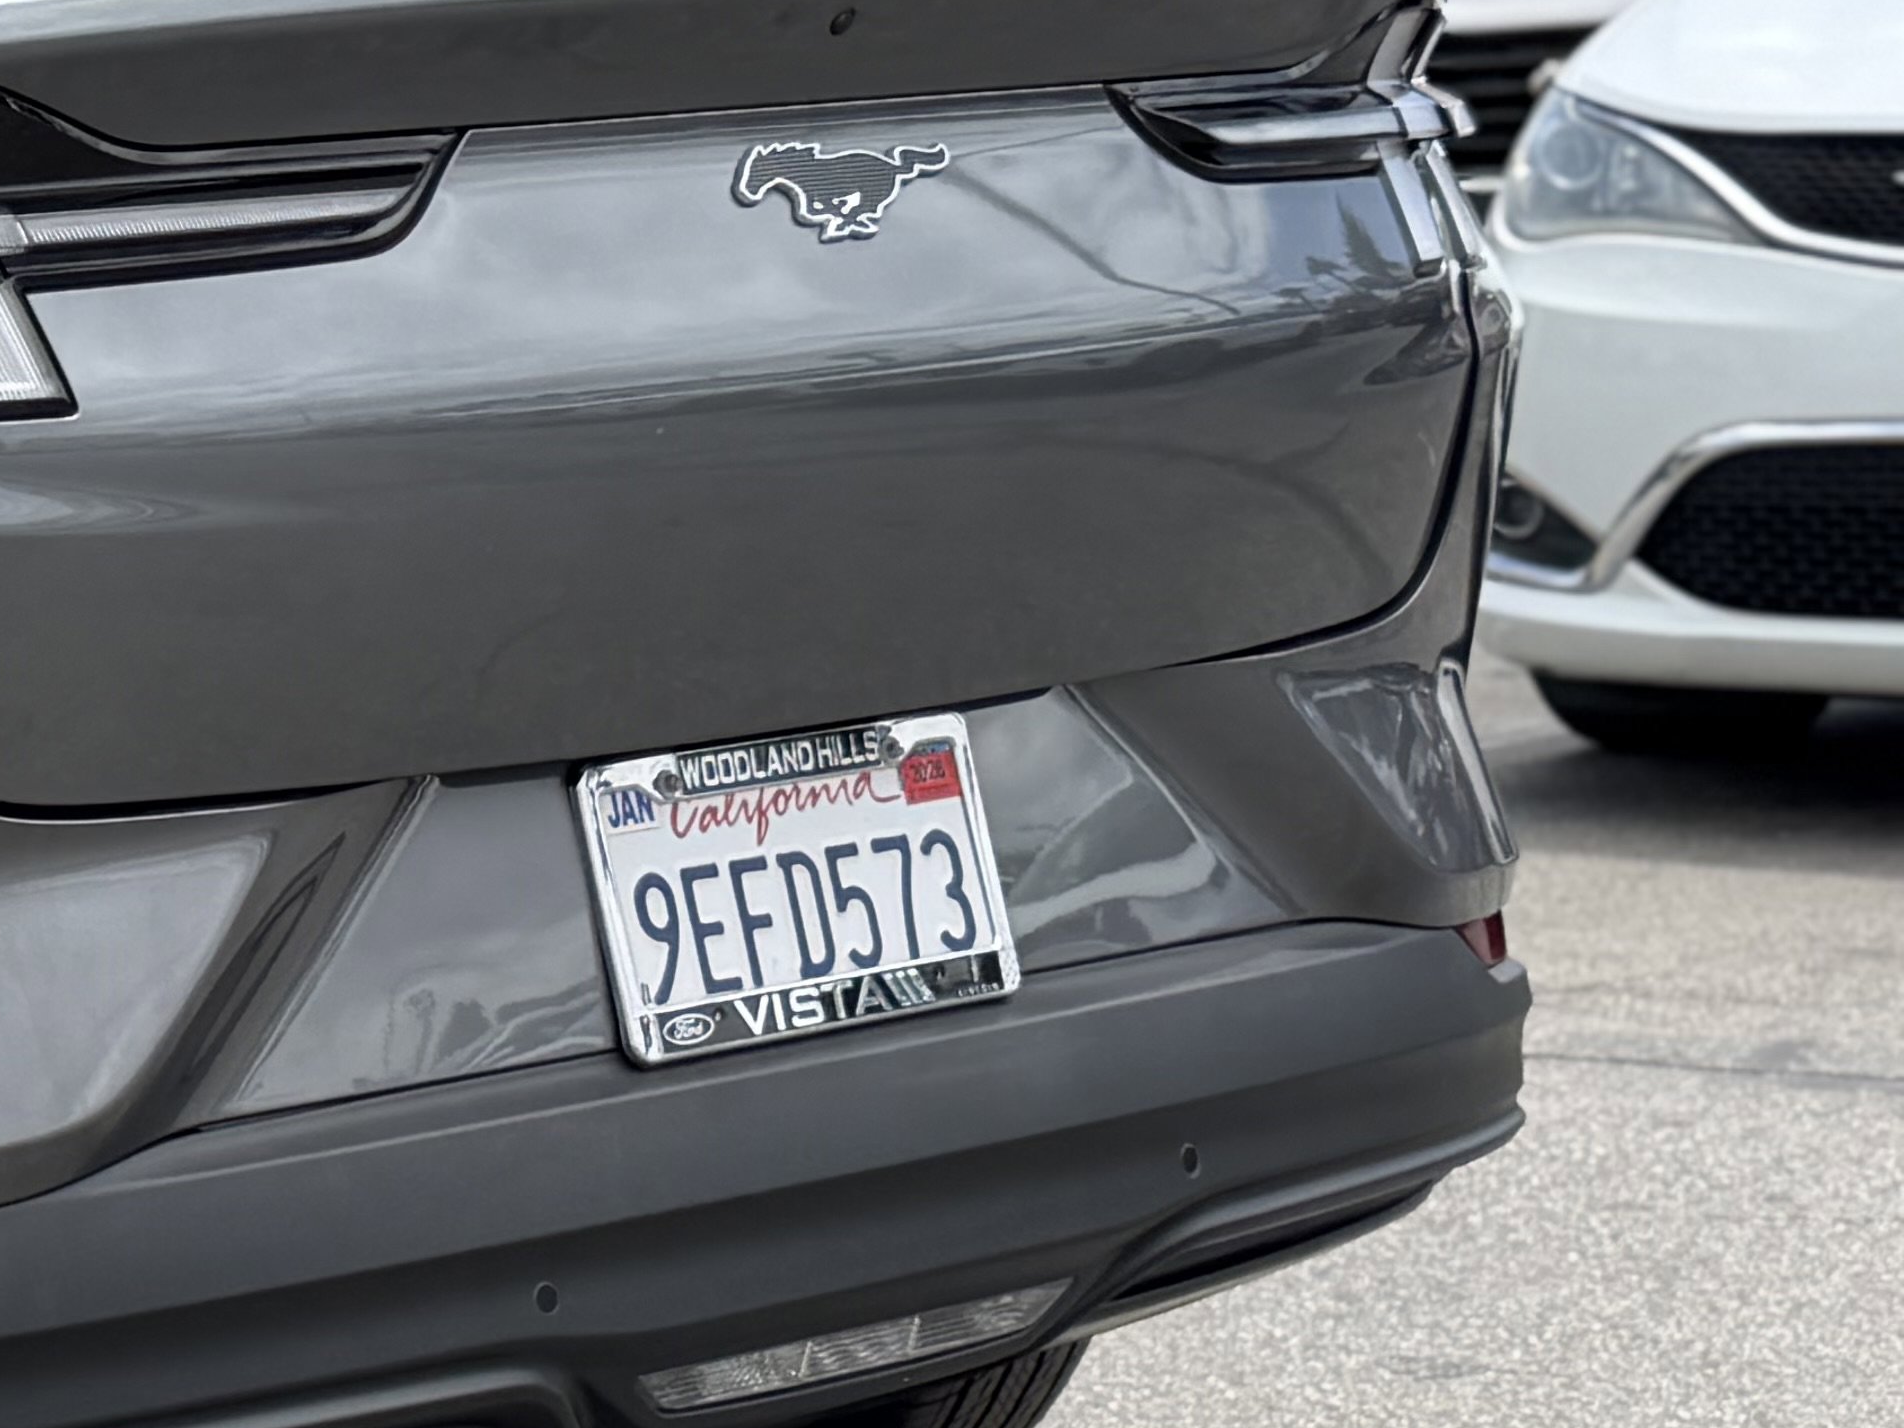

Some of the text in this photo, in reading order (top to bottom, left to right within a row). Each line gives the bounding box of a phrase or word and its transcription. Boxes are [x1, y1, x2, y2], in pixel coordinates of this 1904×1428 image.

[679, 731, 880, 790] WOODLAND HILLS
[607, 789, 655, 828] JAN
[670, 770, 902, 847] California
[633, 828, 977, 1005] 9EFD573
[734, 974, 893, 1035] VISTA
